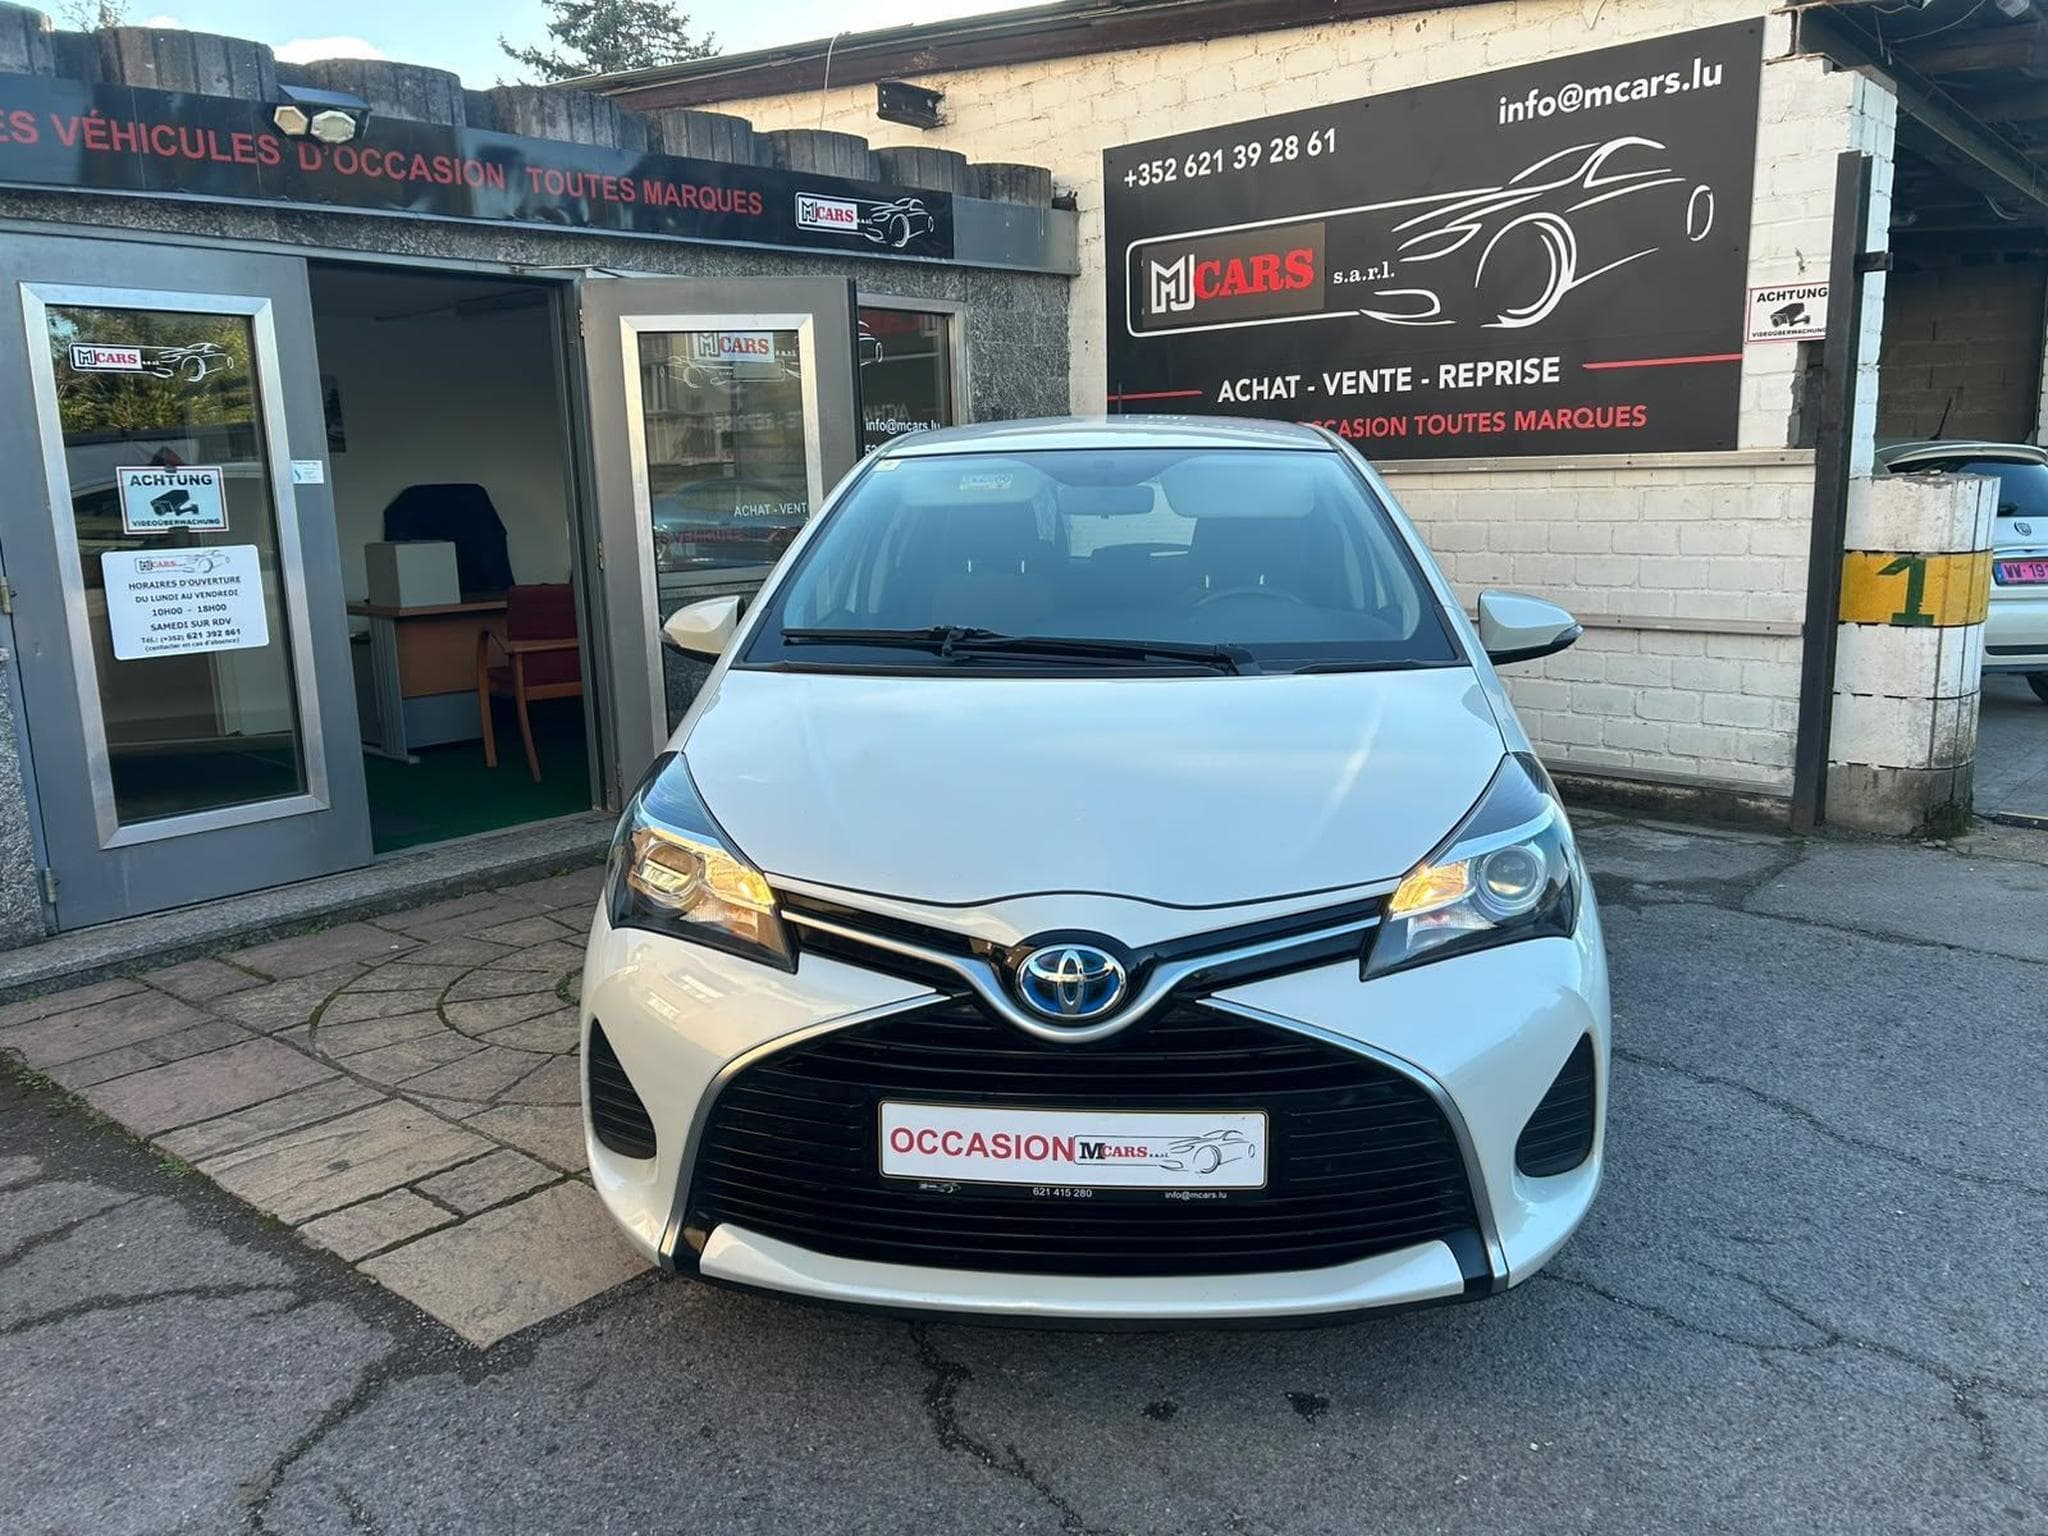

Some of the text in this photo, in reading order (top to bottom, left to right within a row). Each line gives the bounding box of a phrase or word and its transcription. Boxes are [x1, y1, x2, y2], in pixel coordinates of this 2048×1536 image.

[1498, 57, 1723, 125] info@mcars.lu
[50, 109, 280, 165] VÉHICULES
[300, 144, 504, 189] D'OCCASION
[526, 166, 636, 200] TOUTES
[643, 179, 763, 216] MARQUES
[1124, 128, 1336, 188] +352 621 39 28 61
[1333, 261, 1396, 285] s.a.r.l.
[1757, 287, 1828, 303] ACHTUNG
[1217, 375, 1301, 402] ACHAT
[1323, 367, 1412, 396] VENTE
[1439, 356, 1560, 390] REPRISE
[1414, 410, 1506, 436] TOUTES
[1514, 405, 1648, 431] MARQUES
[130, 474, 213, 486] ACHTUNG
[734, 503, 771, 517] ACHAT
[128, 580, 178, 591] HORAIRES
[1876, 556, 1935, 625] 1
[135, 589, 239, 604] DU LUNDI AU VENDREDI
[152, 606, 183, 617] 10H00
[197, 603, 227, 613] 18H00
[150, 617, 232, 631] SAMEDI SUR RDV
[890, 1128, 1075, 1163] OCCASION
[1032, 1187, 1093, 1198] 621 415 280
